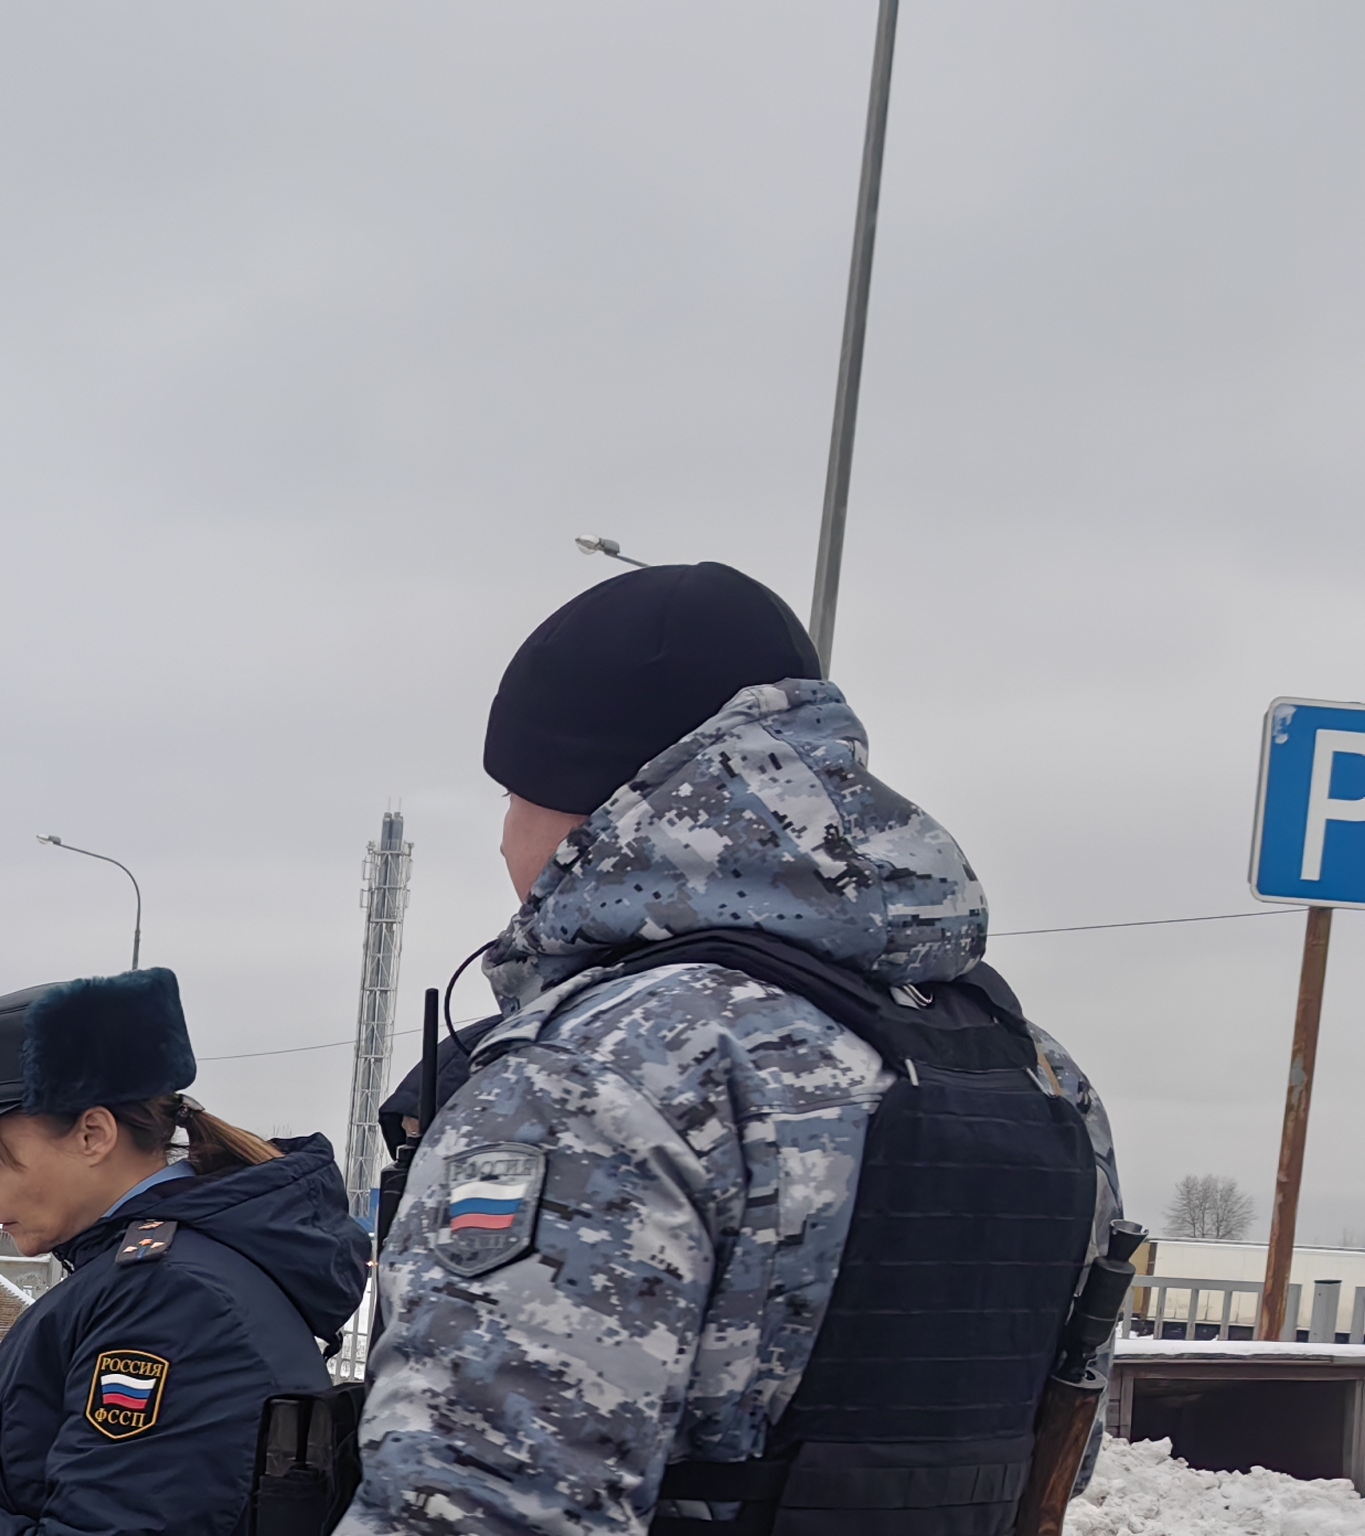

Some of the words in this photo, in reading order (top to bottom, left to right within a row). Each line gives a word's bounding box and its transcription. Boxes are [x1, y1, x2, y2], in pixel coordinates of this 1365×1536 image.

[1300, 729, 1365, 881] P
[101, 1357, 163, 1377] РОССИЯ
[95, 1407, 146, 1427] ФССП
